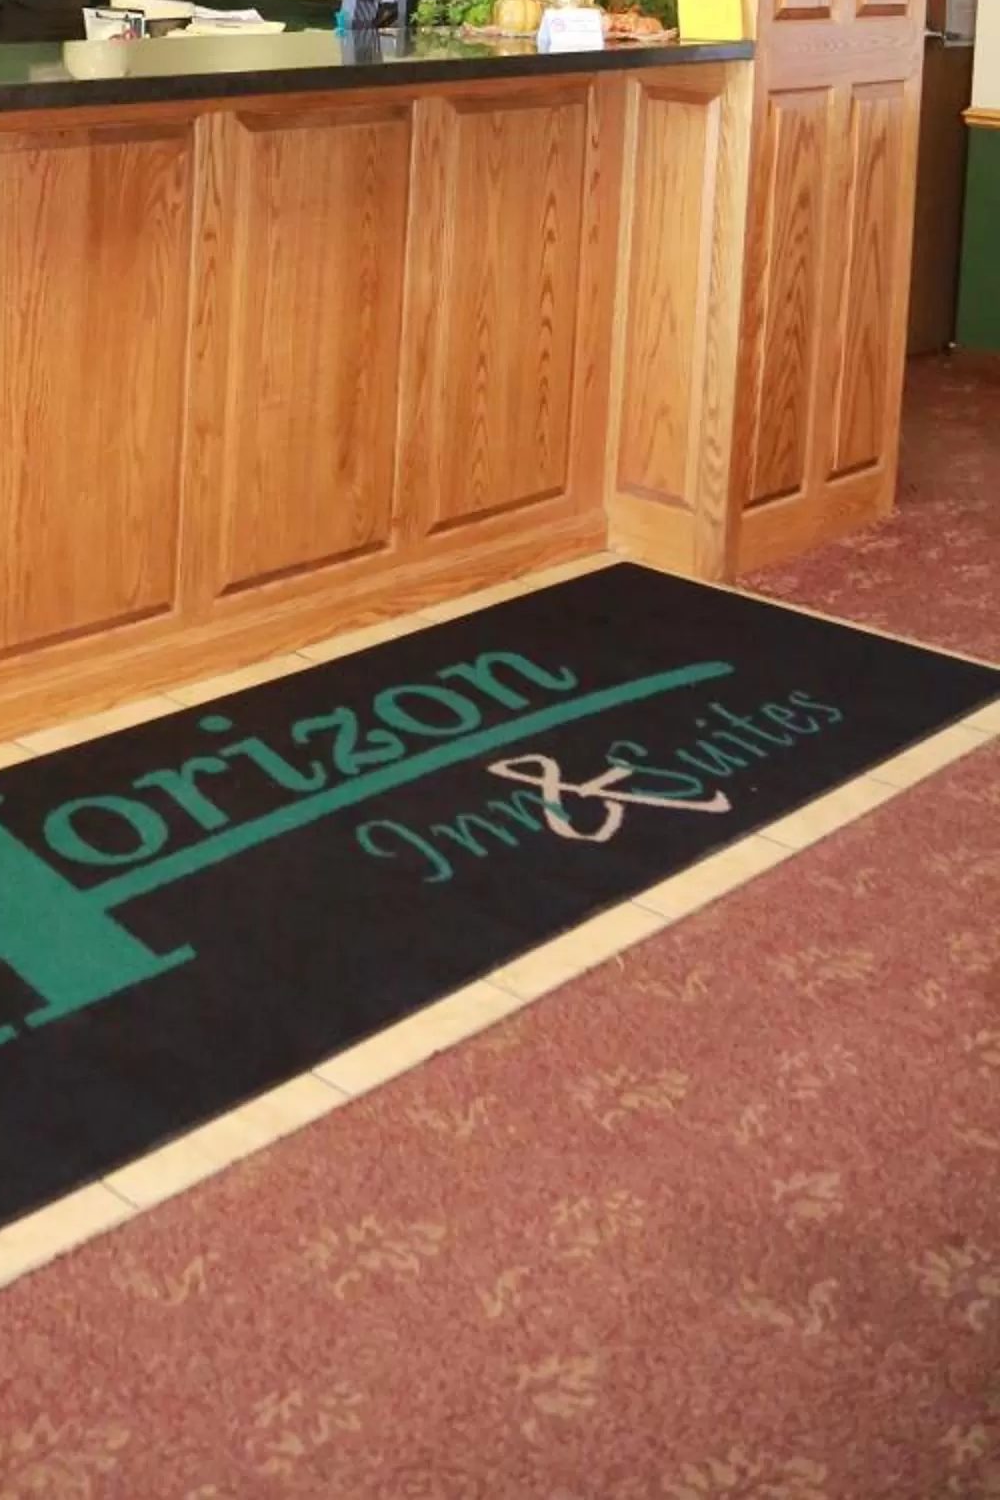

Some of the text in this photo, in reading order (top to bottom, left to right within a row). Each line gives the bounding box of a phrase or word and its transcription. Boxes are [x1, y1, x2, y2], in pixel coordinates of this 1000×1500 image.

[356, 689, 844, 884] Inn & Suites
